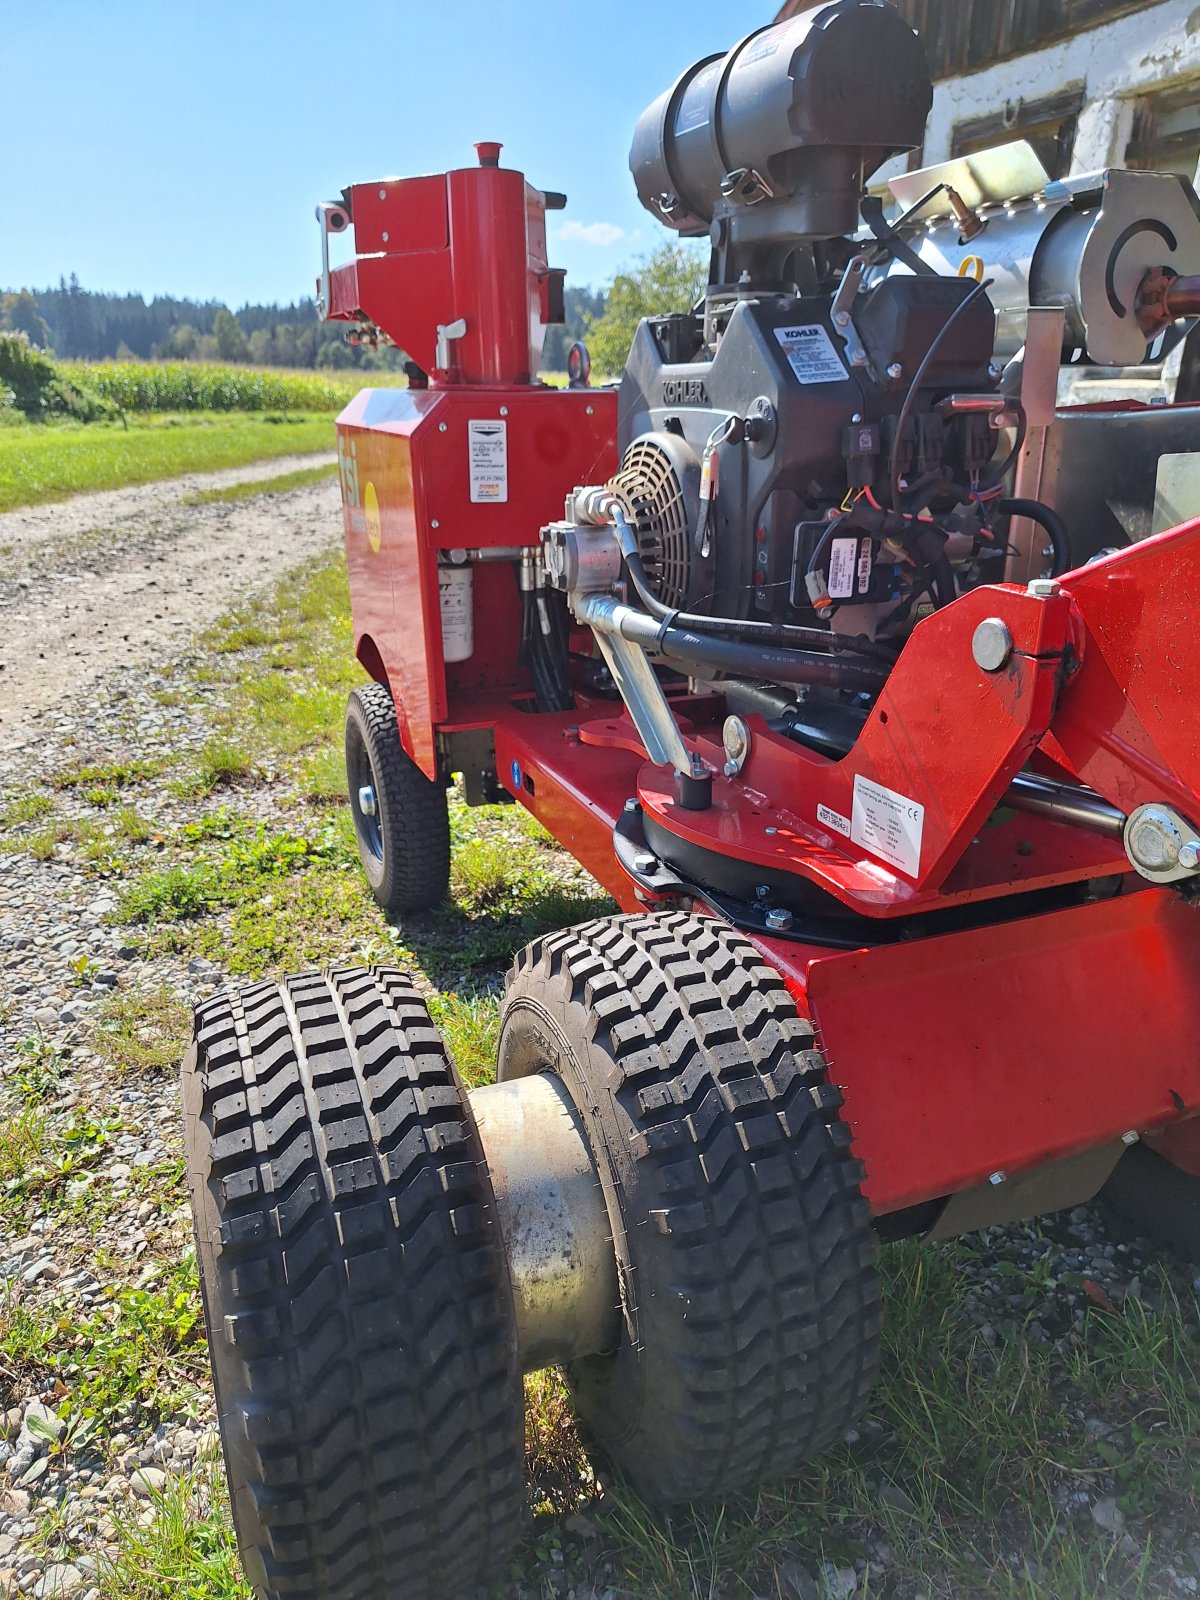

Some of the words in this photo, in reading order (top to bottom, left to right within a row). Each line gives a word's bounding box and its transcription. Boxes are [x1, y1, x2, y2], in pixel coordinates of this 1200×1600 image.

[784, 329, 820, 338] KOHLER
[662, 380, 706, 403] KOHLER
[907, 808, 918, 821] CE
